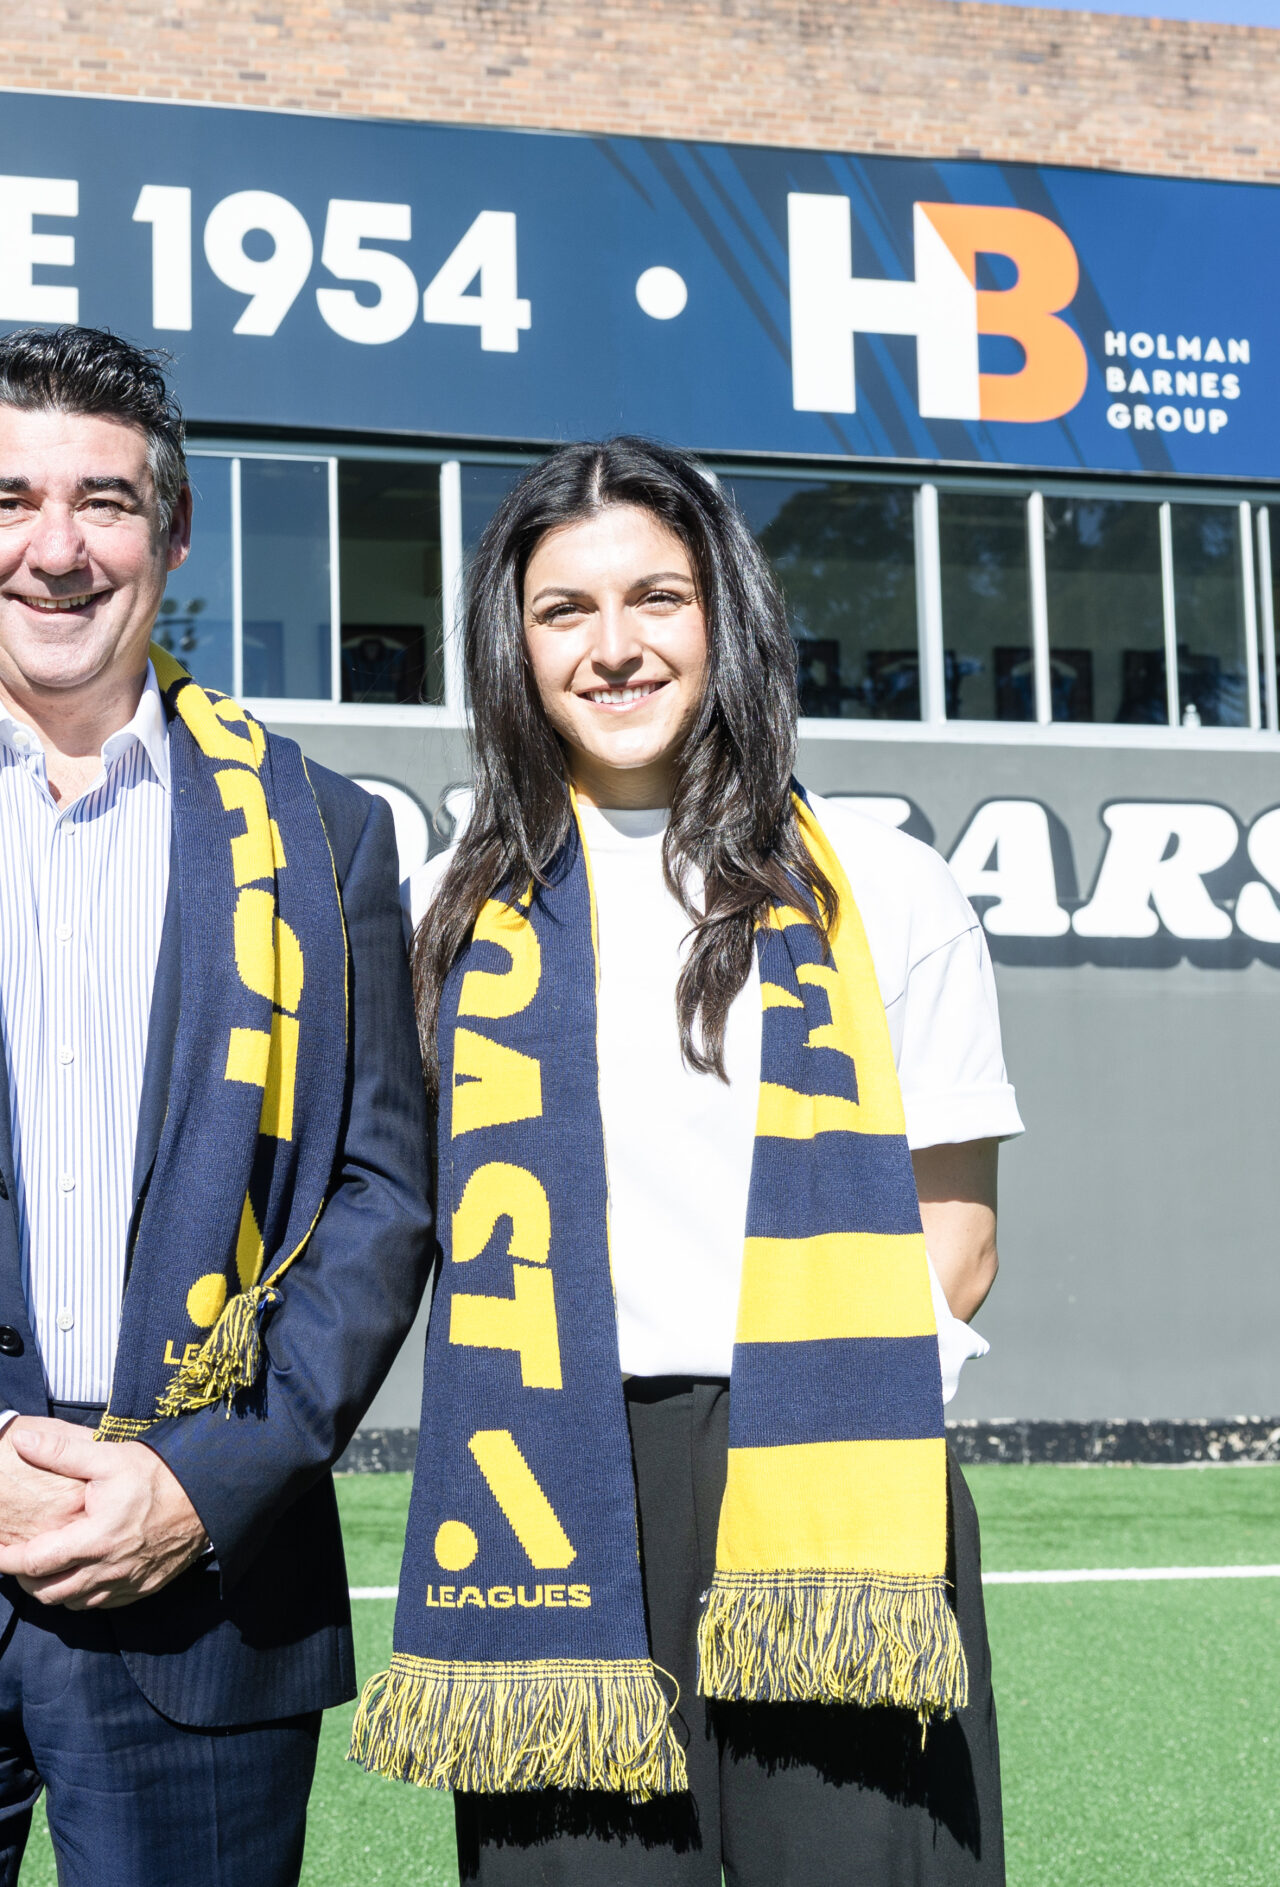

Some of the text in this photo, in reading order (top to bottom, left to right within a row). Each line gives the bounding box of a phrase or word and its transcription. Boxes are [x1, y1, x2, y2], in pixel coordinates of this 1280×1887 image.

[132, 184, 531, 353] 1954
[787, 192, 1088, 423] HB
[1105, 330, 1251, 364] HOLMAN
[1106, 366, 1241, 400] BARNES
[1107, 403, 1229, 435] GROUP
[426, 1584, 592, 1609] LEAGUES
